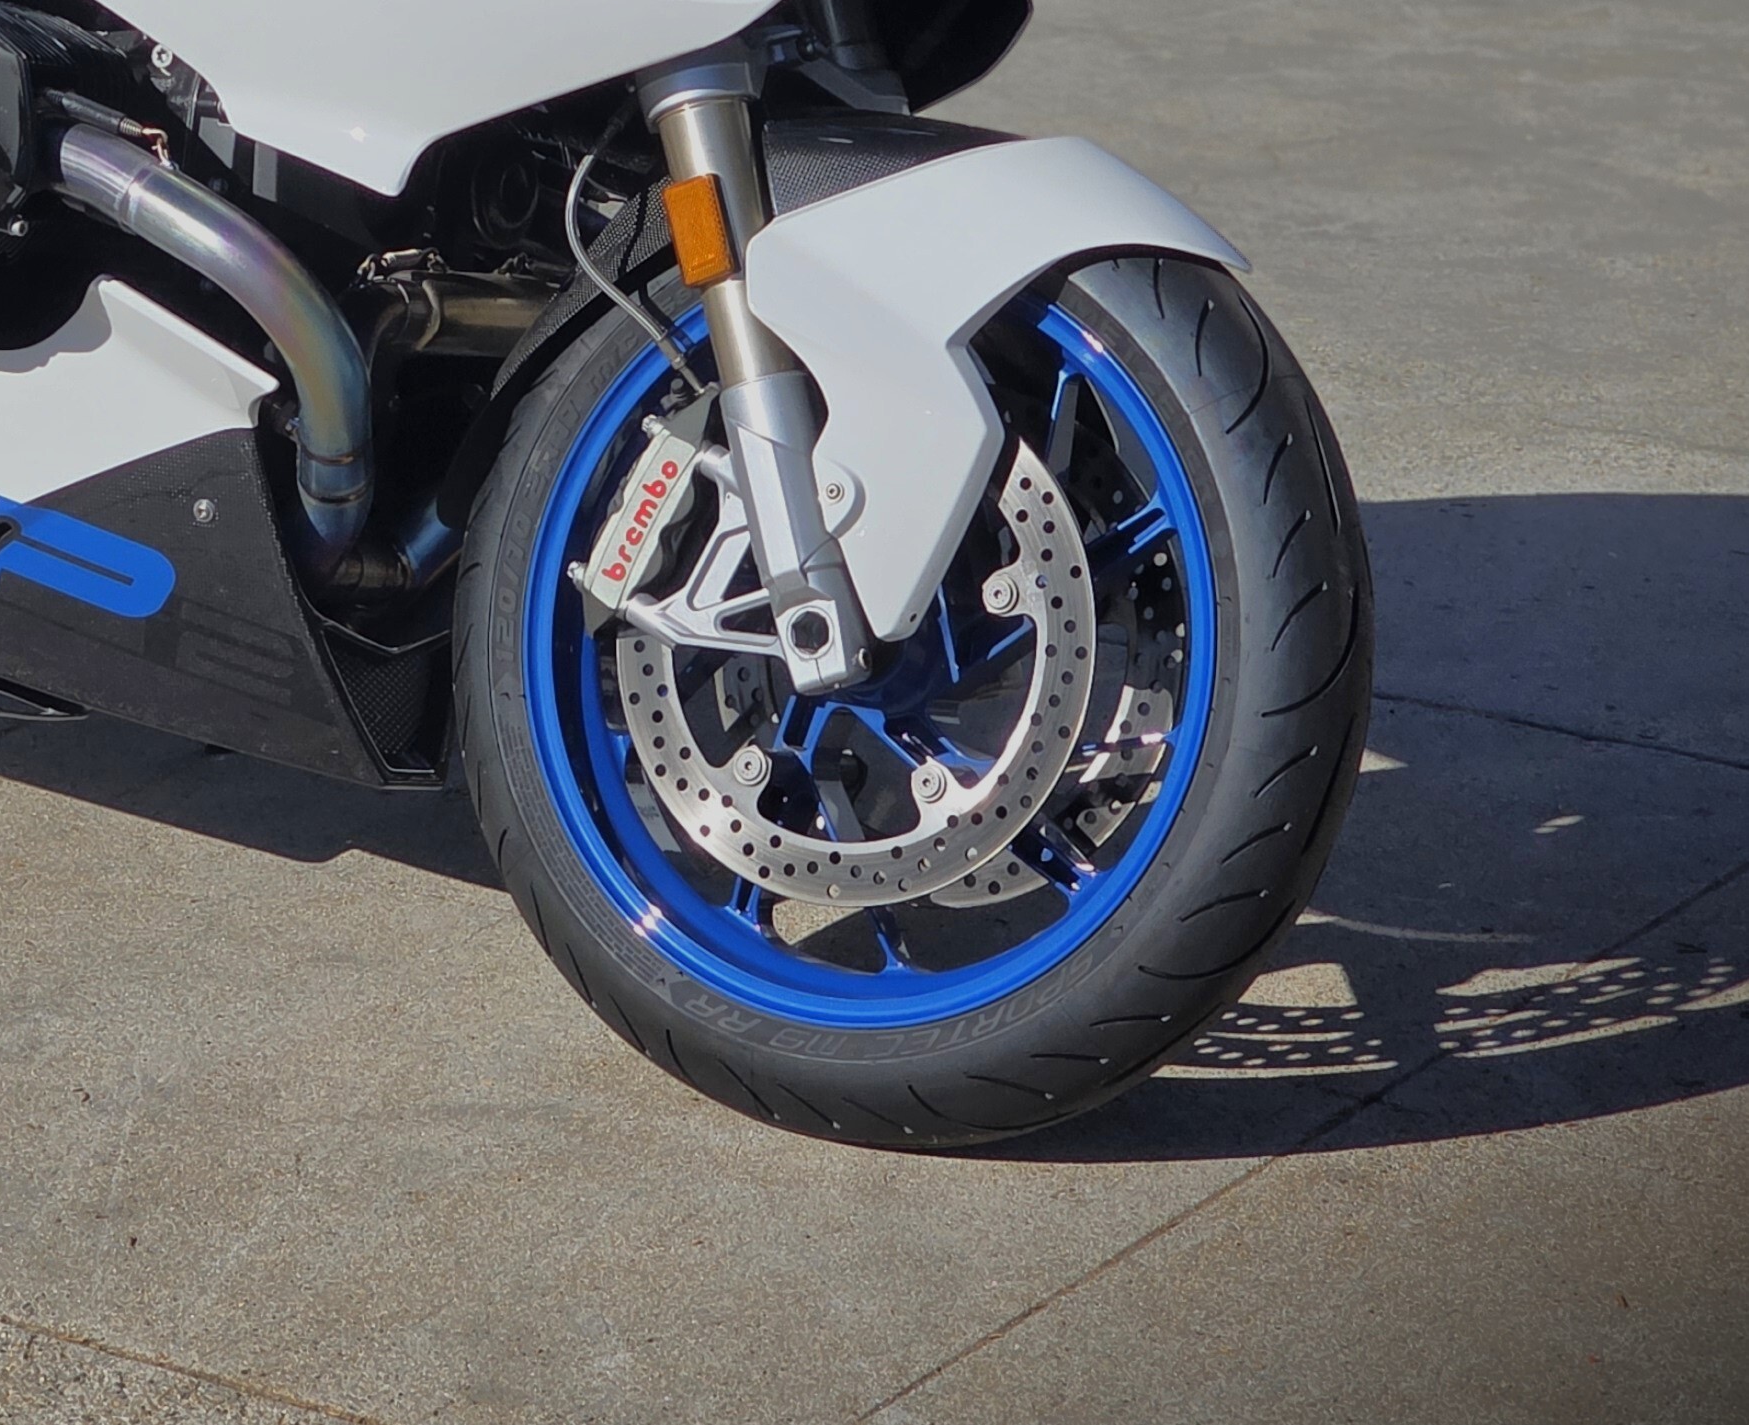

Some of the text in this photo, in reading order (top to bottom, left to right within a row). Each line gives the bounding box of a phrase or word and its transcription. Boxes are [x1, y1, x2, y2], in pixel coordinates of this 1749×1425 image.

[601, 460, 679, 582] brembo
[494, 508, 534, 661] 120/70
[684, 994, 763, 1034] RR
[867, 951, 1094, 1059] SPORTEC
